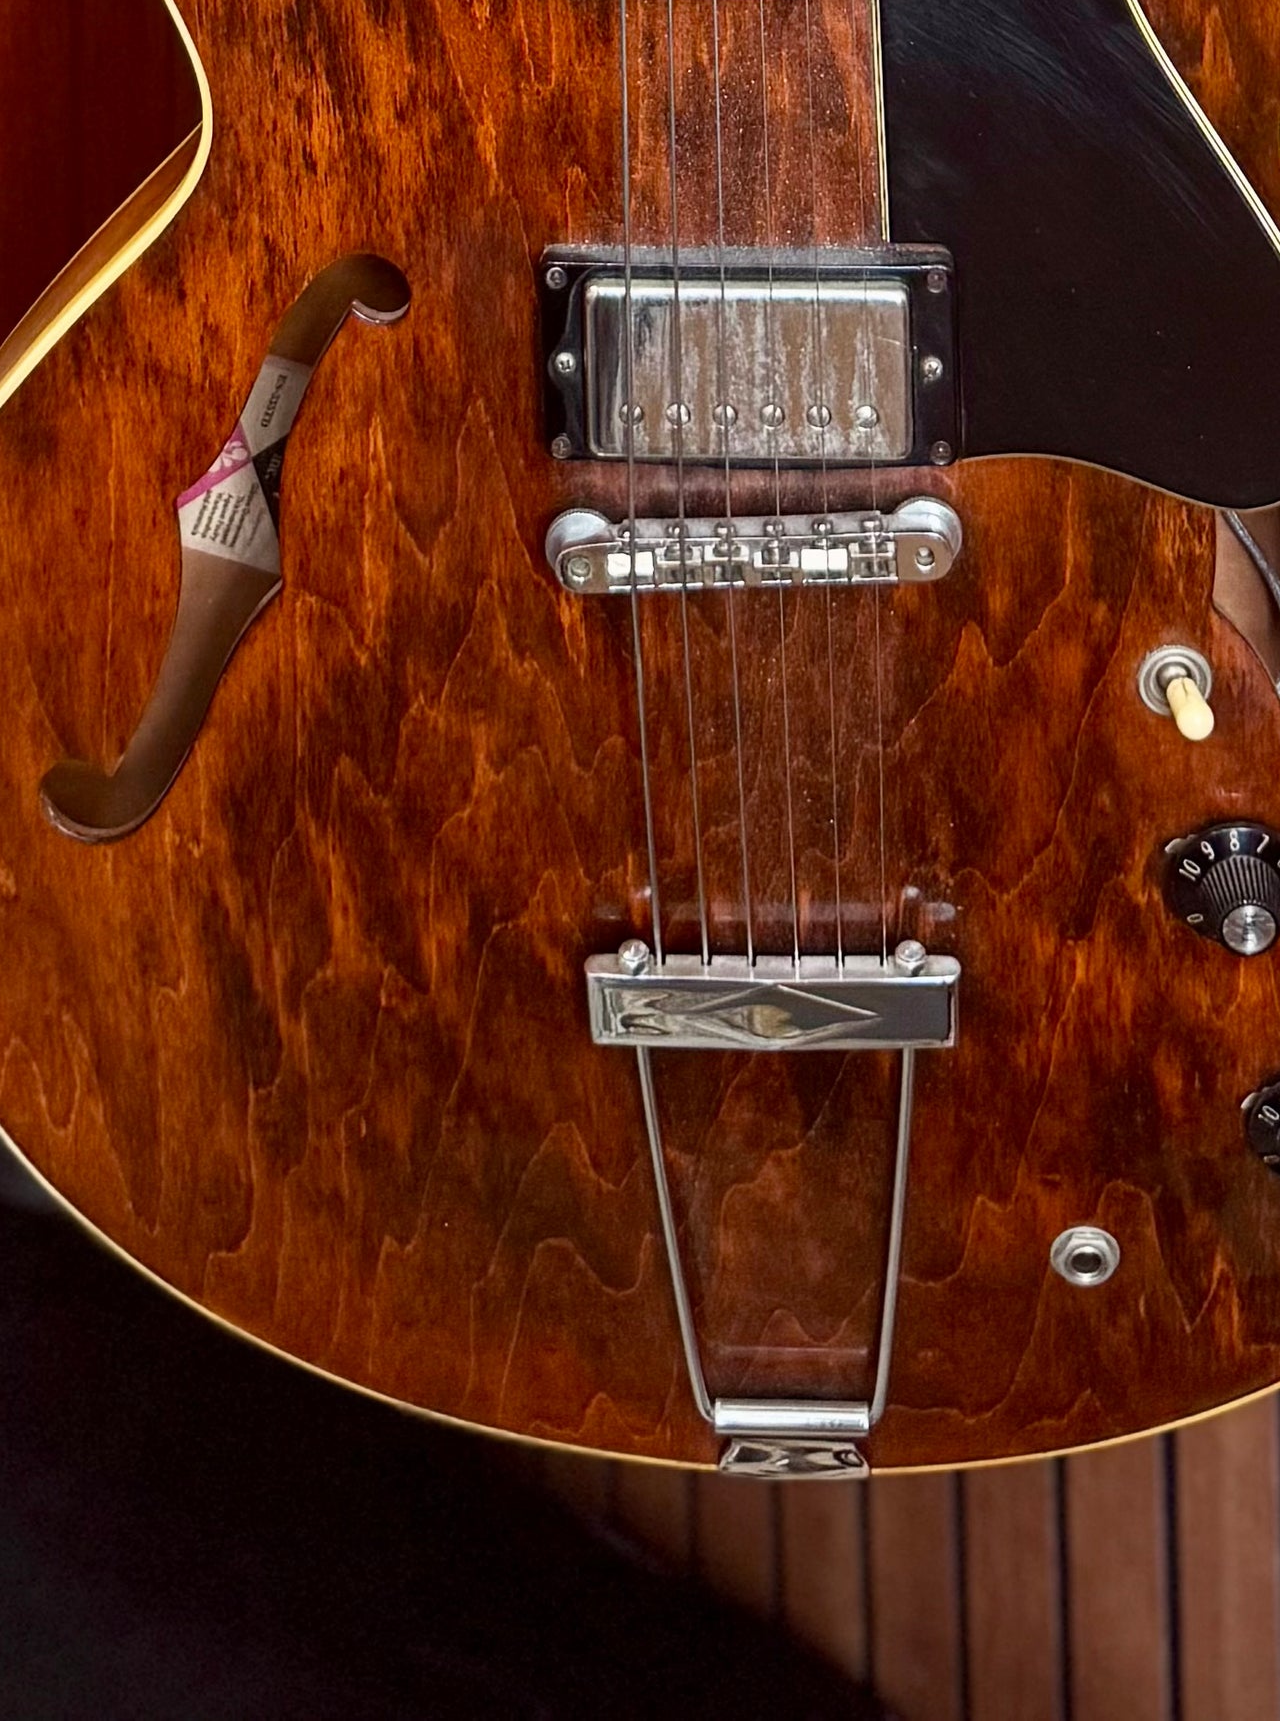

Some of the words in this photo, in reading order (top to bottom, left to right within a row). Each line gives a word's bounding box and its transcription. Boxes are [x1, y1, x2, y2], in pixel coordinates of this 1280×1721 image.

[1179, 859, 1200, 881] 10
[1201, 841, 1215, 859] 9
[1229, 829, 1240, 851] 8
[1257, 833, 1269, 853] 7
[1258, 1105, 1279, 1126] 10
